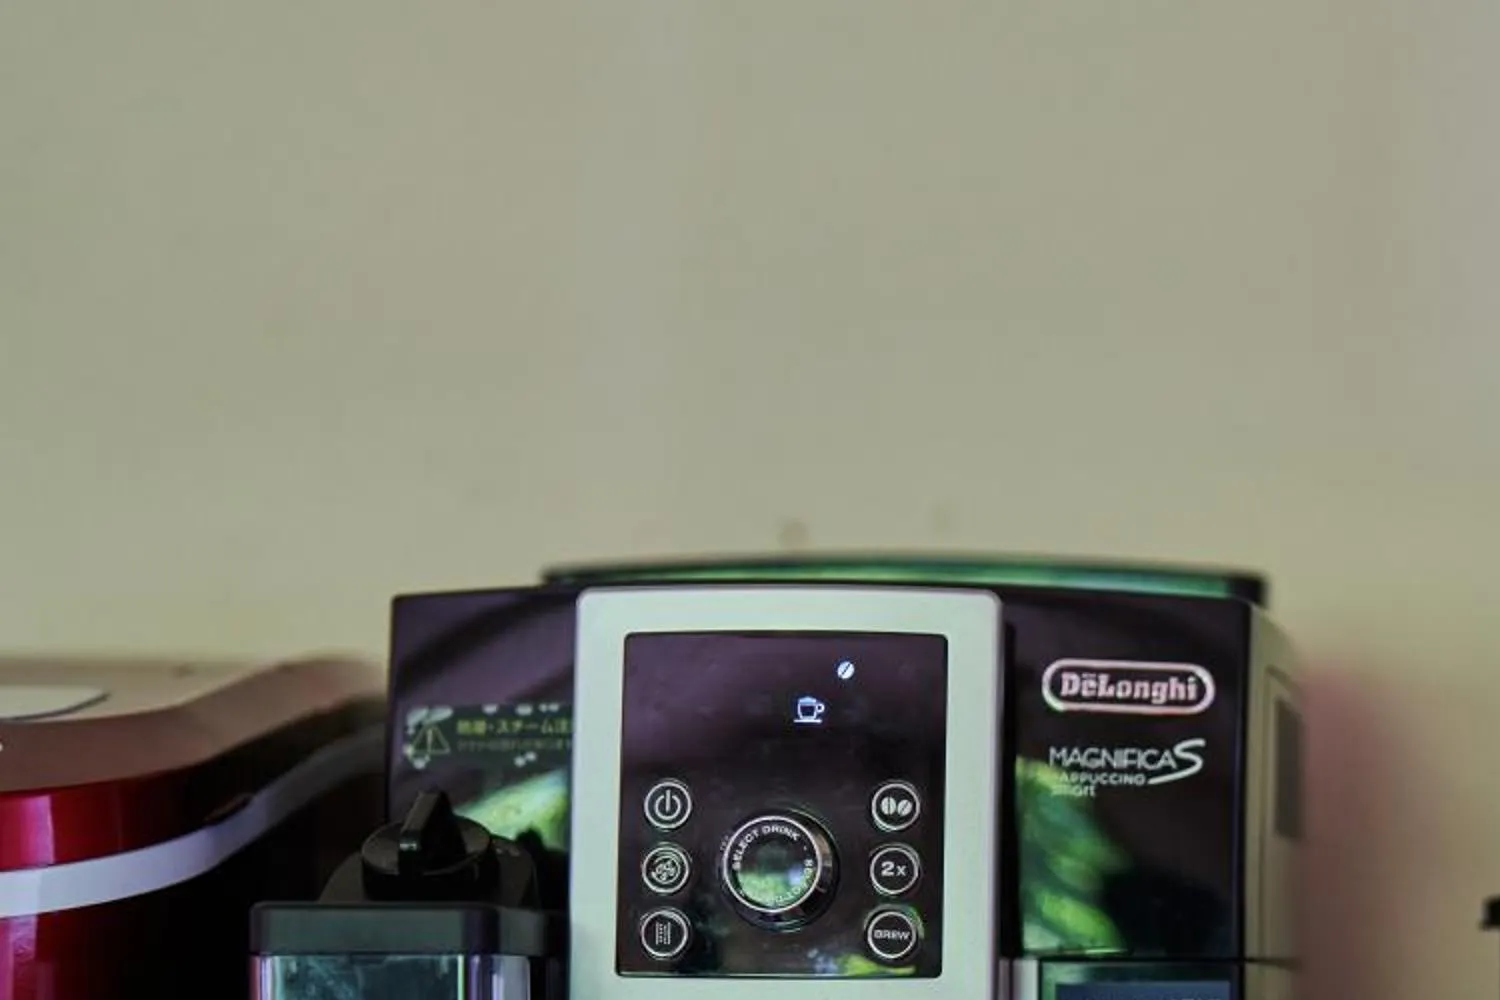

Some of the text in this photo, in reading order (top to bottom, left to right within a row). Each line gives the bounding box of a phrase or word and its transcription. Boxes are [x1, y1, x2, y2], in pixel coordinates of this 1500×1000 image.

[1052, 771, 1147, 786] APPUCCINO
[732, 825, 801, 871] SELECT DRINK
[881, 860, 907, 877] 2x
